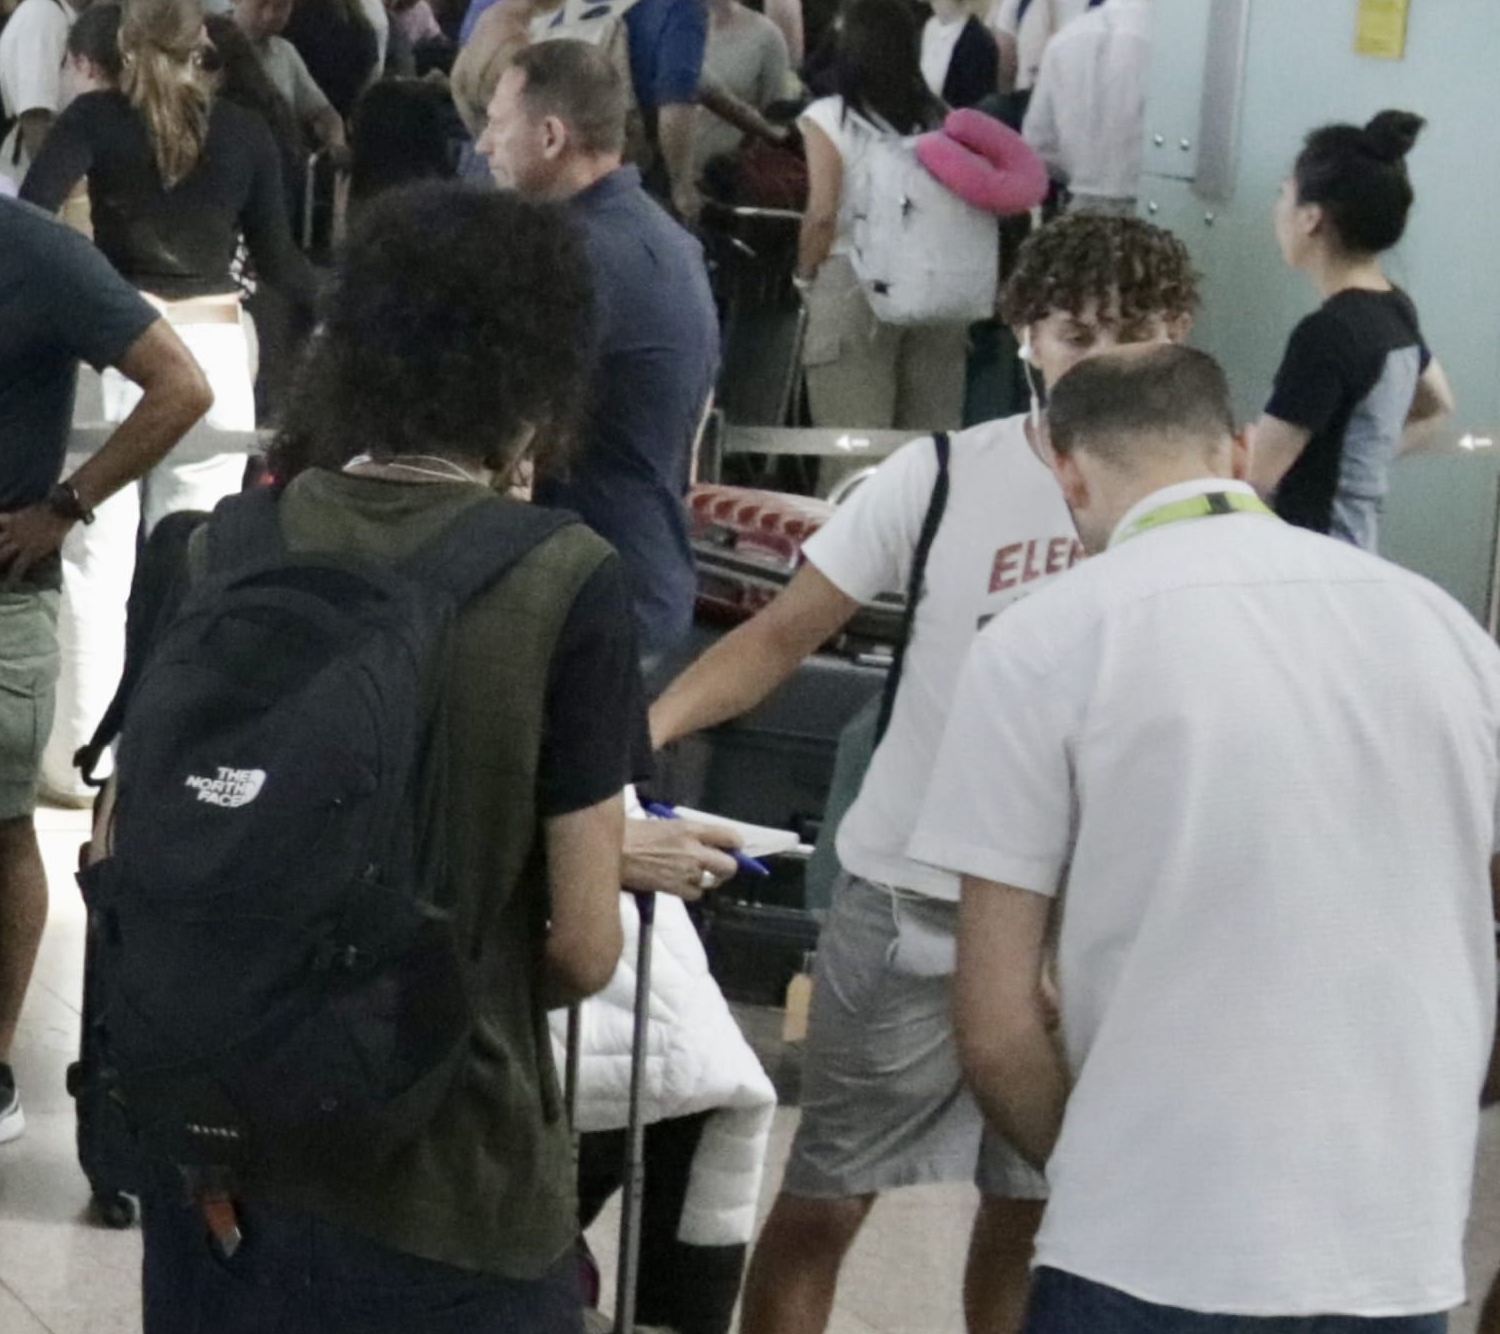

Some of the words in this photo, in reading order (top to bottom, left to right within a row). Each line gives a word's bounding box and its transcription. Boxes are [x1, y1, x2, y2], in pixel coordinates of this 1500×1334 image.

[217, 766, 252, 782] THE
[184, 774, 247, 796] NORTH
[196, 789, 243, 808] FACE
